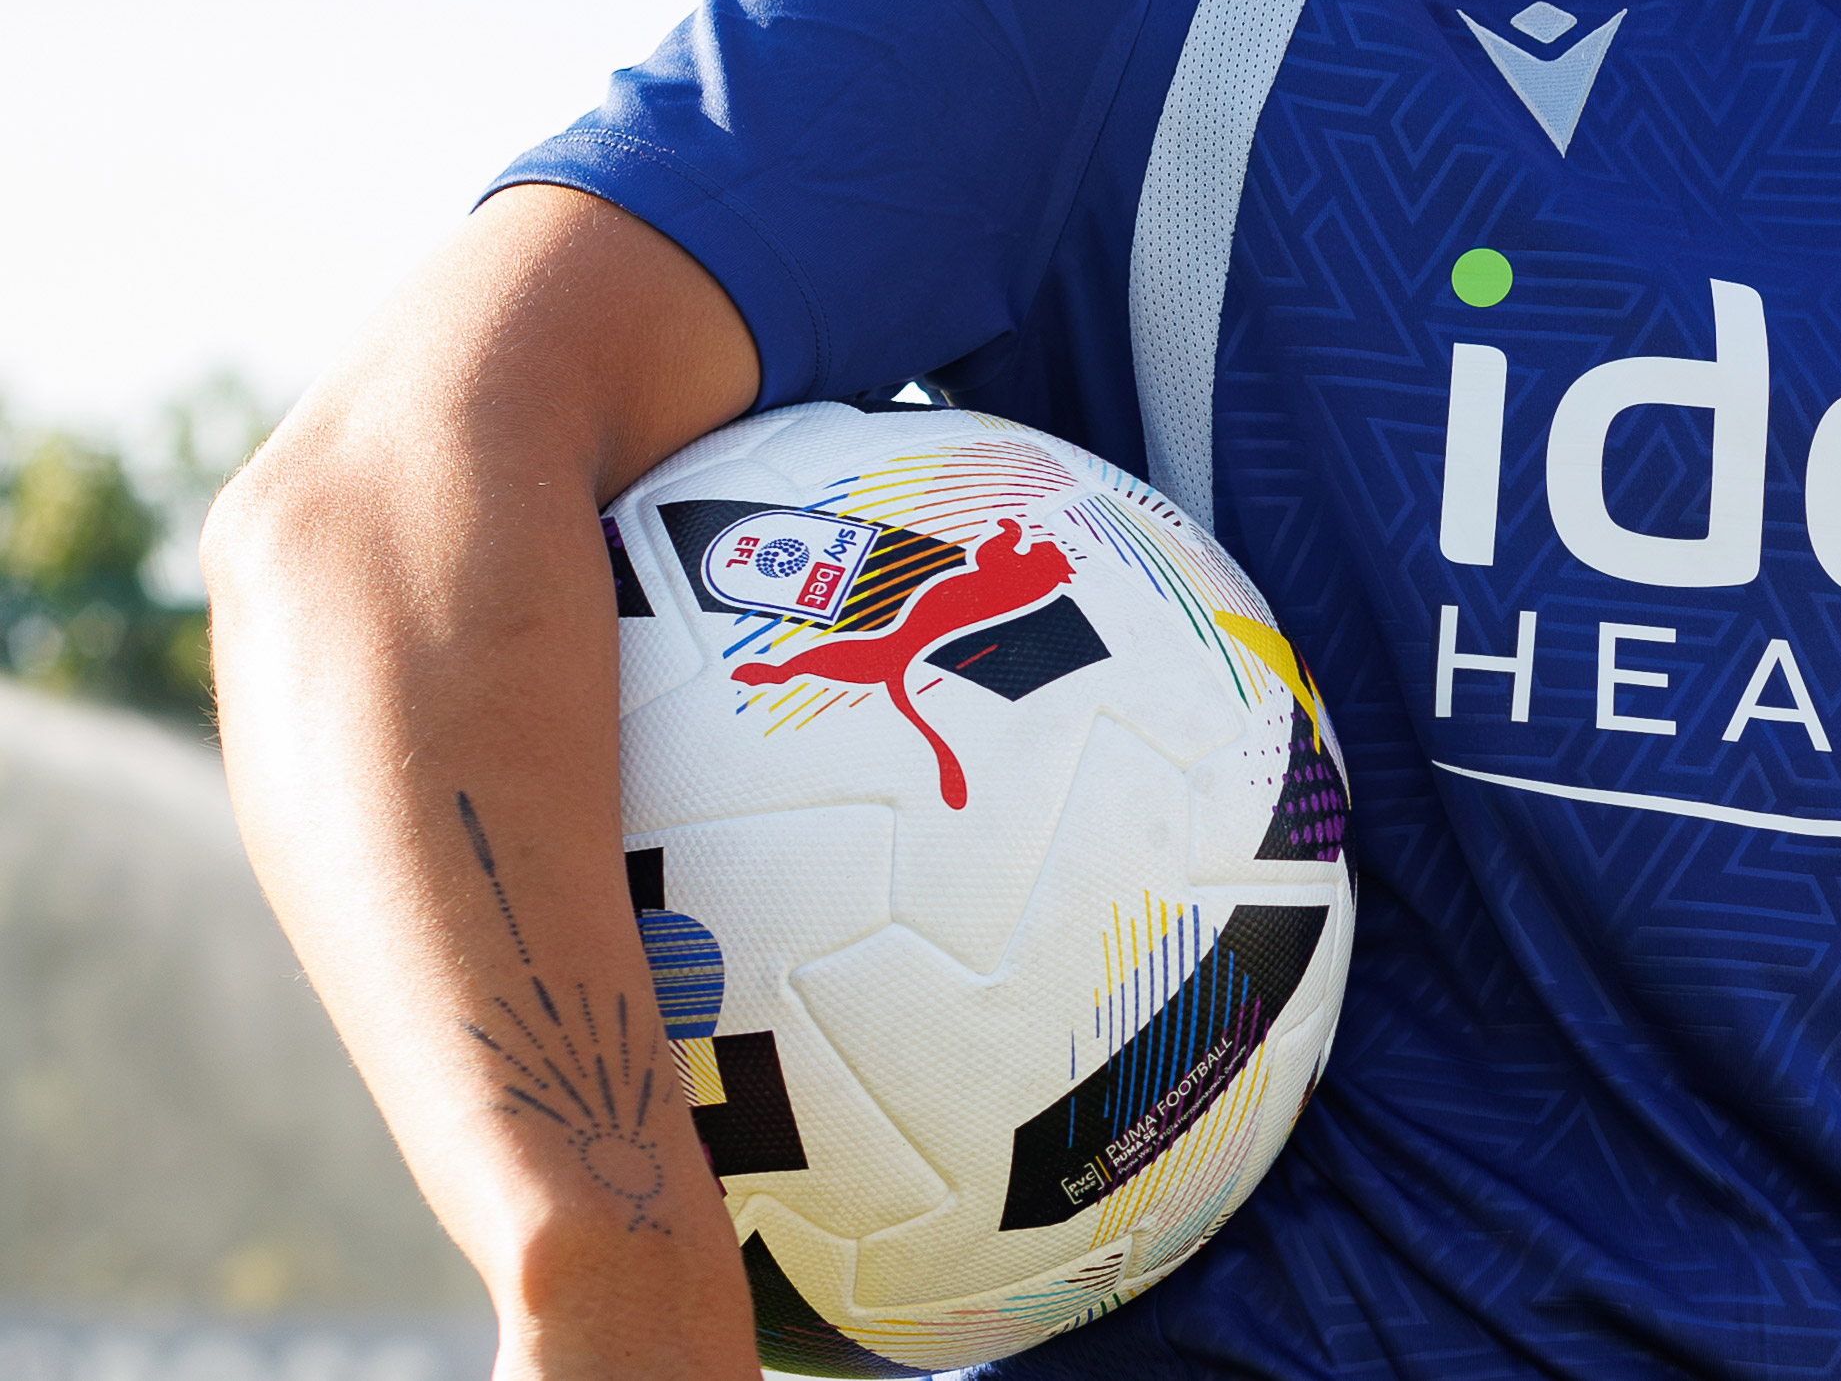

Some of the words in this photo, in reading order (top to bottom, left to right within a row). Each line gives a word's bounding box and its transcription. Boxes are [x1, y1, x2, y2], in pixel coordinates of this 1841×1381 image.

[726, 536, 760, 568] EFL
[823, 528, 857, 563] sky
[804, 568, 840, 606] bet
[1105, 1114, 1158, 1160] PUMA
[1156, 1037, 1233, 1116] FOOTBALL
[1112, 1140, 1144, 1168] PUMA
[1142, 1127, 1158, 1143] SE
[1068, 1171, 1096, 1193] PVC
[1073, 1180, 1097, 1197] Free
